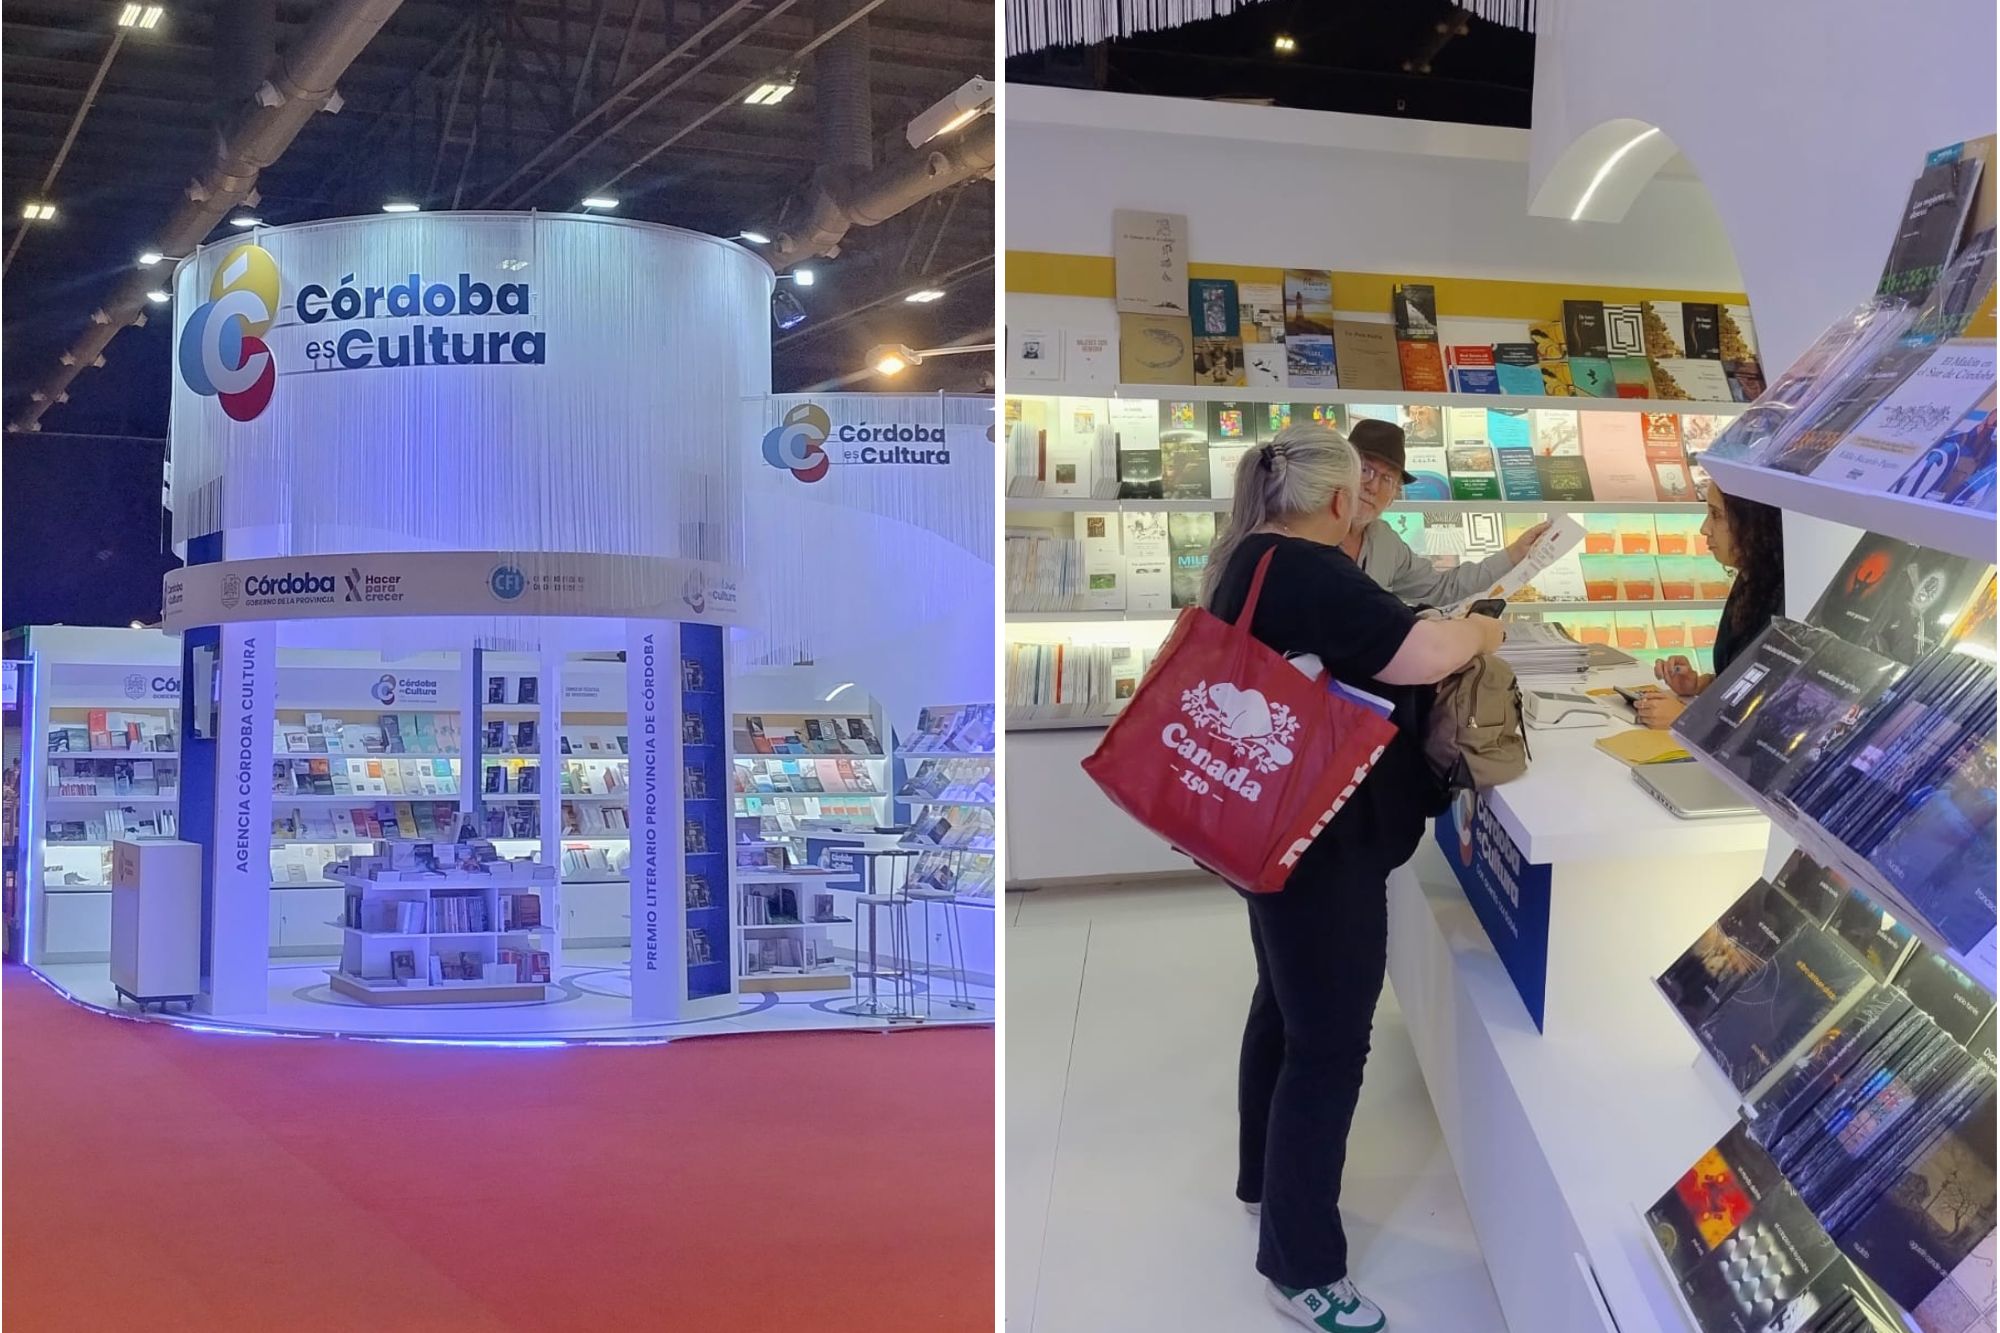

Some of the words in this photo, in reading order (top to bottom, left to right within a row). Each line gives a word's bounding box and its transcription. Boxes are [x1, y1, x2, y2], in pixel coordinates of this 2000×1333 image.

[296, 272, 529, 324] Córdoba
[305, 340, 335, 360] es
[337, 325, 546, 369] Cultura
[839, 422, 945, 443] Córdoba
[843, 450, 859, 460] es
[861, 446, 950, 464] Cultura
[245, 572, 335, 596] Córdoba
[365, 574, 401, 584] Hacer
[365, 584, 396, 594] para
[365, 592, 404, 601] crecer
[241, 638, 256, 710] CULTURA
[399, 678, 437, 688] Córdoba
[641, 634, 655, 711] CÓRDOBA
[645, 715, 656, 734] DE
[236, 714, 253, 795] CÓRDOBA
[1162, 723, 1262, 801] Canada
[645, 738, 657, 824] PROVINCIA
[1179, 769, 1210, 795] 150
[236, 799, 250, 873] AGENCIA
[646, 829, 657, 907] LITERARIO
[1481, 831, 1519, 909] Cultura
[646, 911, 657, 970] PREMIO
